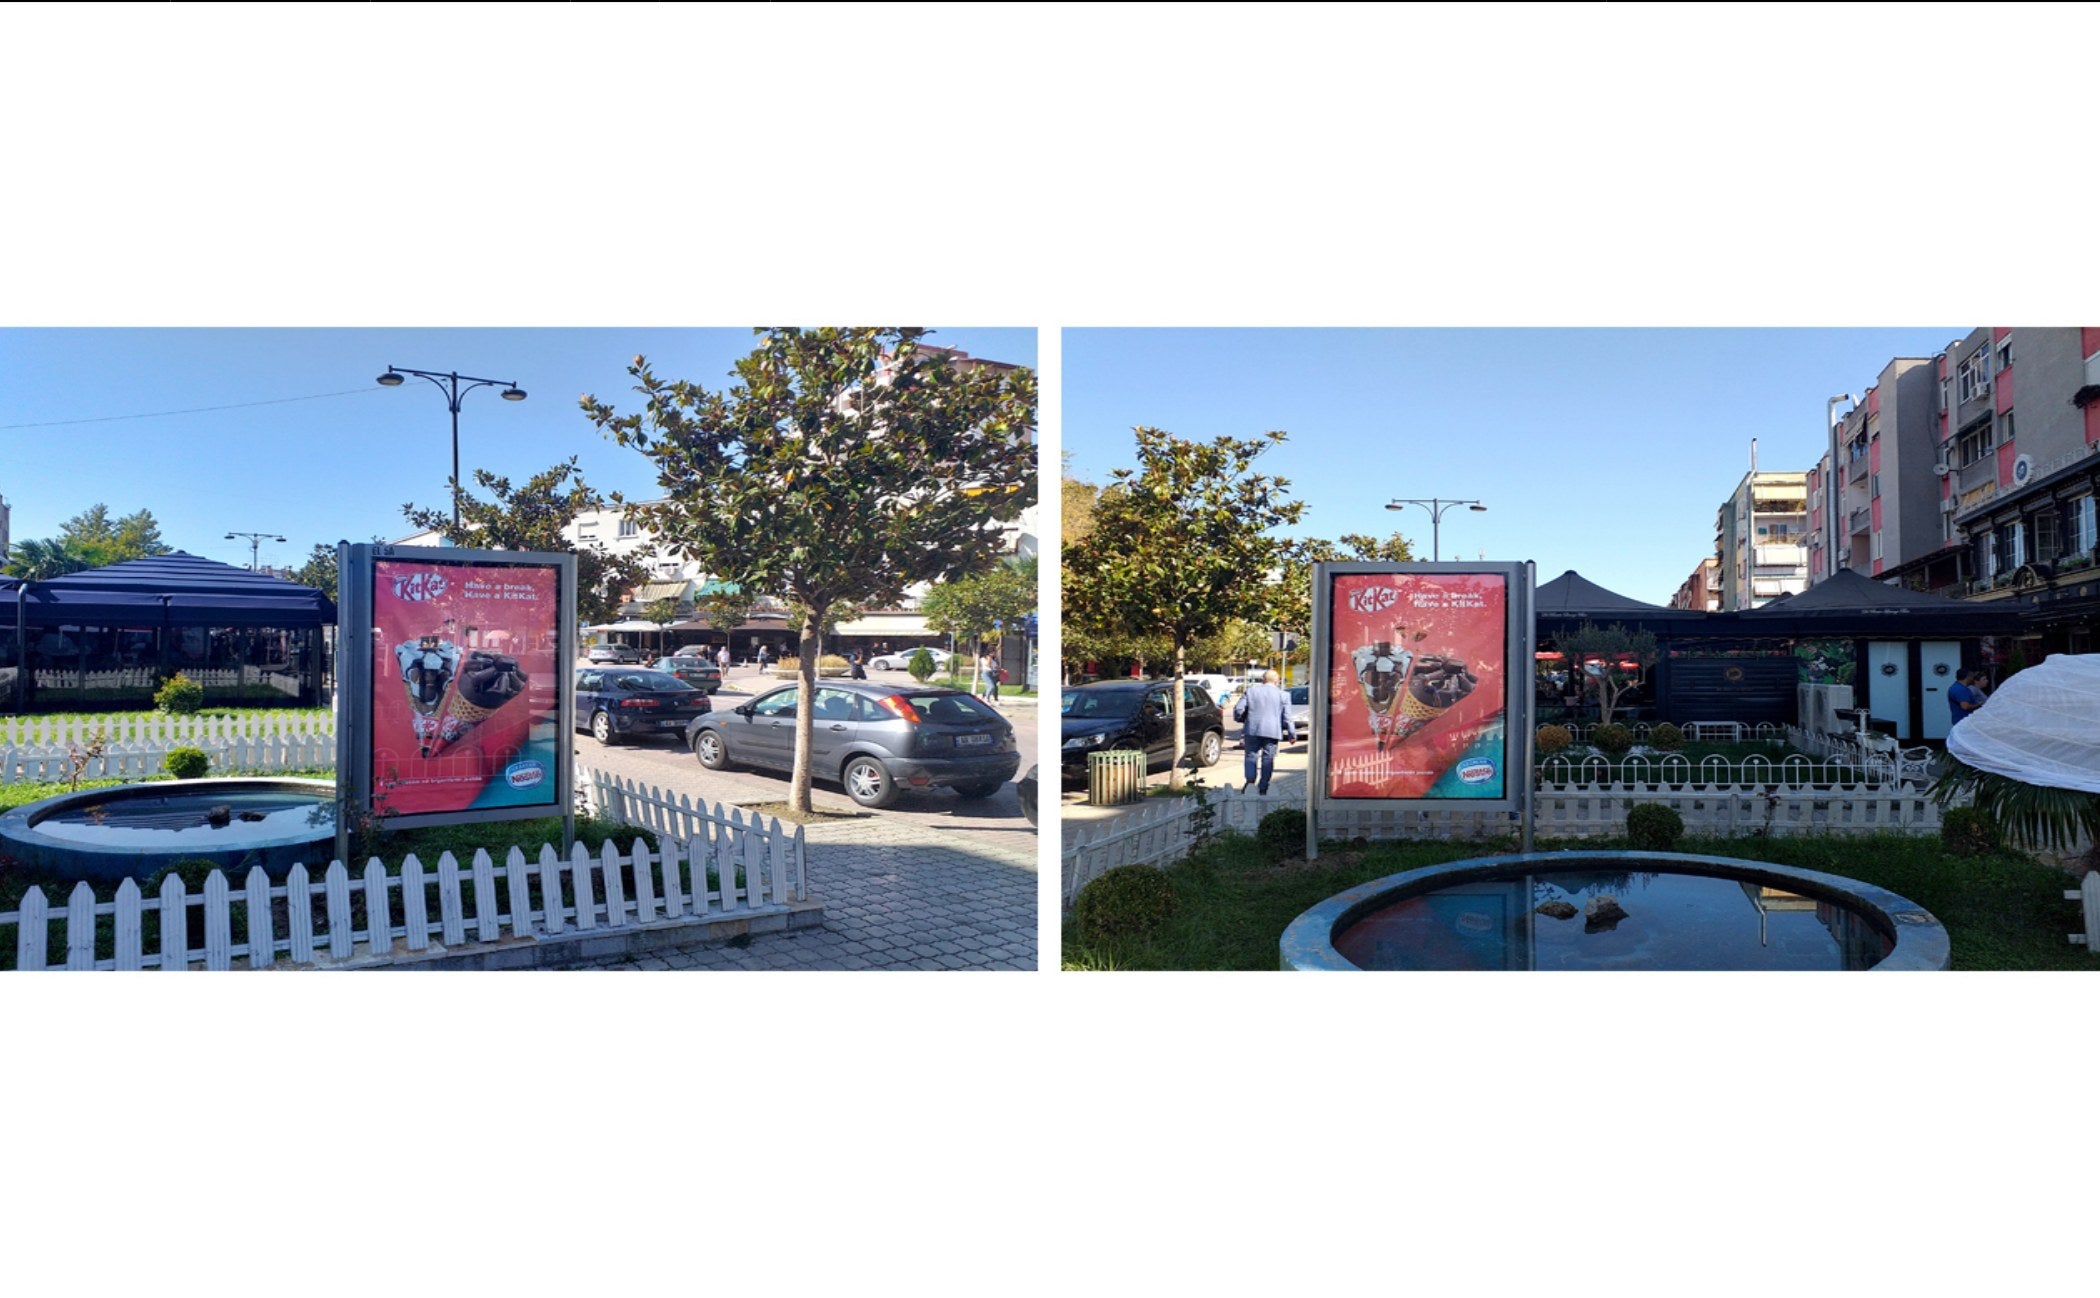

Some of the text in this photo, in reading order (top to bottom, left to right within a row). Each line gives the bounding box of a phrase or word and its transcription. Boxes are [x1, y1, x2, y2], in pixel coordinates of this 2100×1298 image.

[398, 572, 446, 601] KitKat
[465, 582, 491, 590] Have
[464, 591, 491, 599] Have
[1352, 586, 1396, 612] KitKat
